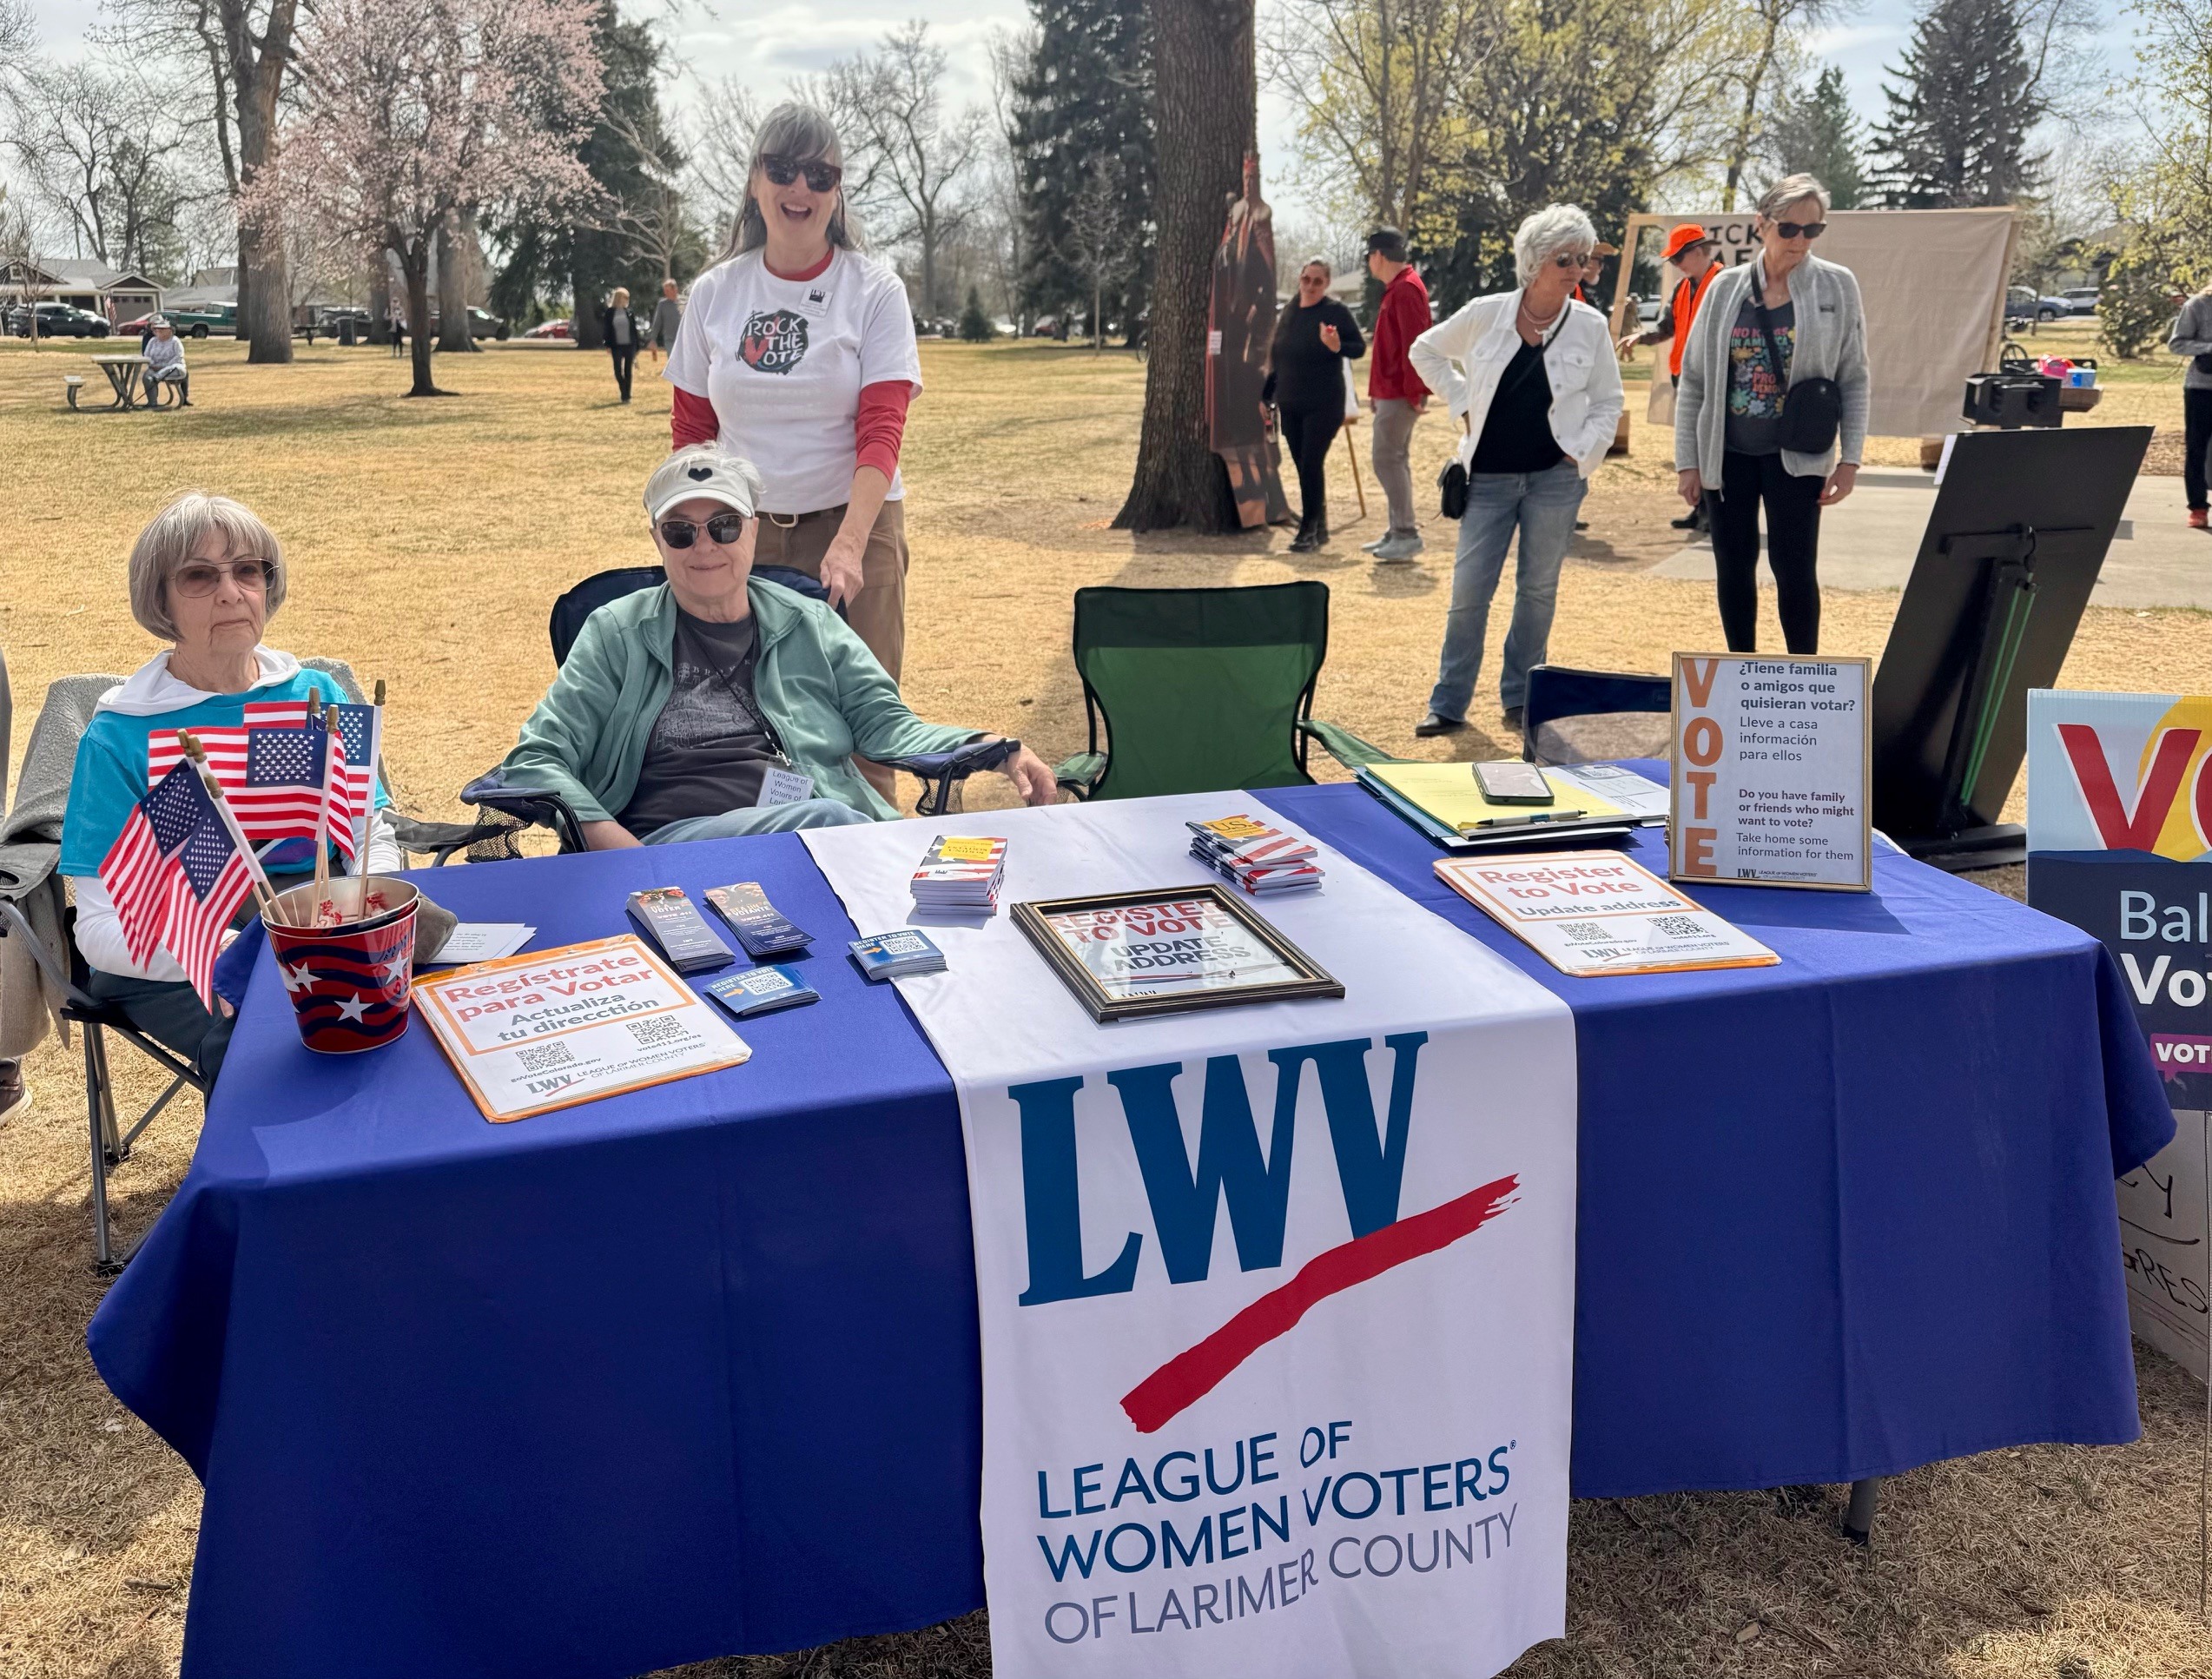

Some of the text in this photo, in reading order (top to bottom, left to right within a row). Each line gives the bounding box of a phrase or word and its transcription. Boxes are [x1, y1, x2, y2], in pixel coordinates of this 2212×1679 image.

[748, 317, 803, 336] ROCK
[744, 335, 803, 365] VOTE
[767, 332, 803, 350] THE
[1739, 662, 1838, 677] ¿Tiene familia
[1740, 680, 1836, 695] o amigos que
[1740, 697, 1856, 711] quisieran votar?
[1740, 716, 1818, 730] Lleve a casa
[1740, 733, 1818, 746] información
[1740, 750, 1802, 762] para ellos
[1680, 658, 1724, 876] VOTE
[773, 770, 799, 783] League
[775, 779, 802, 792] Women
[770, 788, 792, 799] Voters
[1739, 789, 1846, 804] Do you have family
[1739, 803, 1855, 818] or friends who might
[1211, 820, 1252, 831] U.S.
[1738, 816, 1813, 828] want to vote?
[1737, 832, 1829, 846] Take home some
[1738, 847, 1854, 861] information for them
[1477, 866, 1626, 883] Register
[1738, 869, 1757, 878] LWV
[1507, 880, 1643, 899] to Vote
[1516, 899, 1681, 917] Update address
[1064, 914, 1238, 943] TO VOTE
[853, 935, 888, 946] REGISTER
[1111, 935, 1228, 956] UPDATE
[1114, 946, 1251, 971] ADDRESS
[1581, 948, 1621, 958] LWV
[444, 955, 639, 1003] Regístrate
[711, 975, 747, 989] REGISTER
[756, 967, 776, 975] VOTE
[456, 968, 653, 1022] para Votar
[716, 983, 736, 993] HERE
[512, 994, 625, 1026] Actualiza
[498, 1029, 527, 1041] tu
[637, 1034, 702, 1052] vote411.org/es
[2155, 1042, 2212, 1064] VOT
[511, 1057, 601, 1083] goVoteColorado.gov
[577, 1065, 615, 1077] LEAGUE
[627, 1050, 669, 1065] WOMEN
[606, 1062, 645, 1075] LARIMER
[644, 1053, 684, 1067] COUNTY
[526, 1074, 573, 1094] LWV
[1007, 1030, 1429, 1307] LWV
[1038, 1420, 1353, 1518] LEAGUE OF
[1037, 1494, 1290, 1583] WOMEN
[1044, 1504, 1518, 1643] OF LARIMER COUNTY
